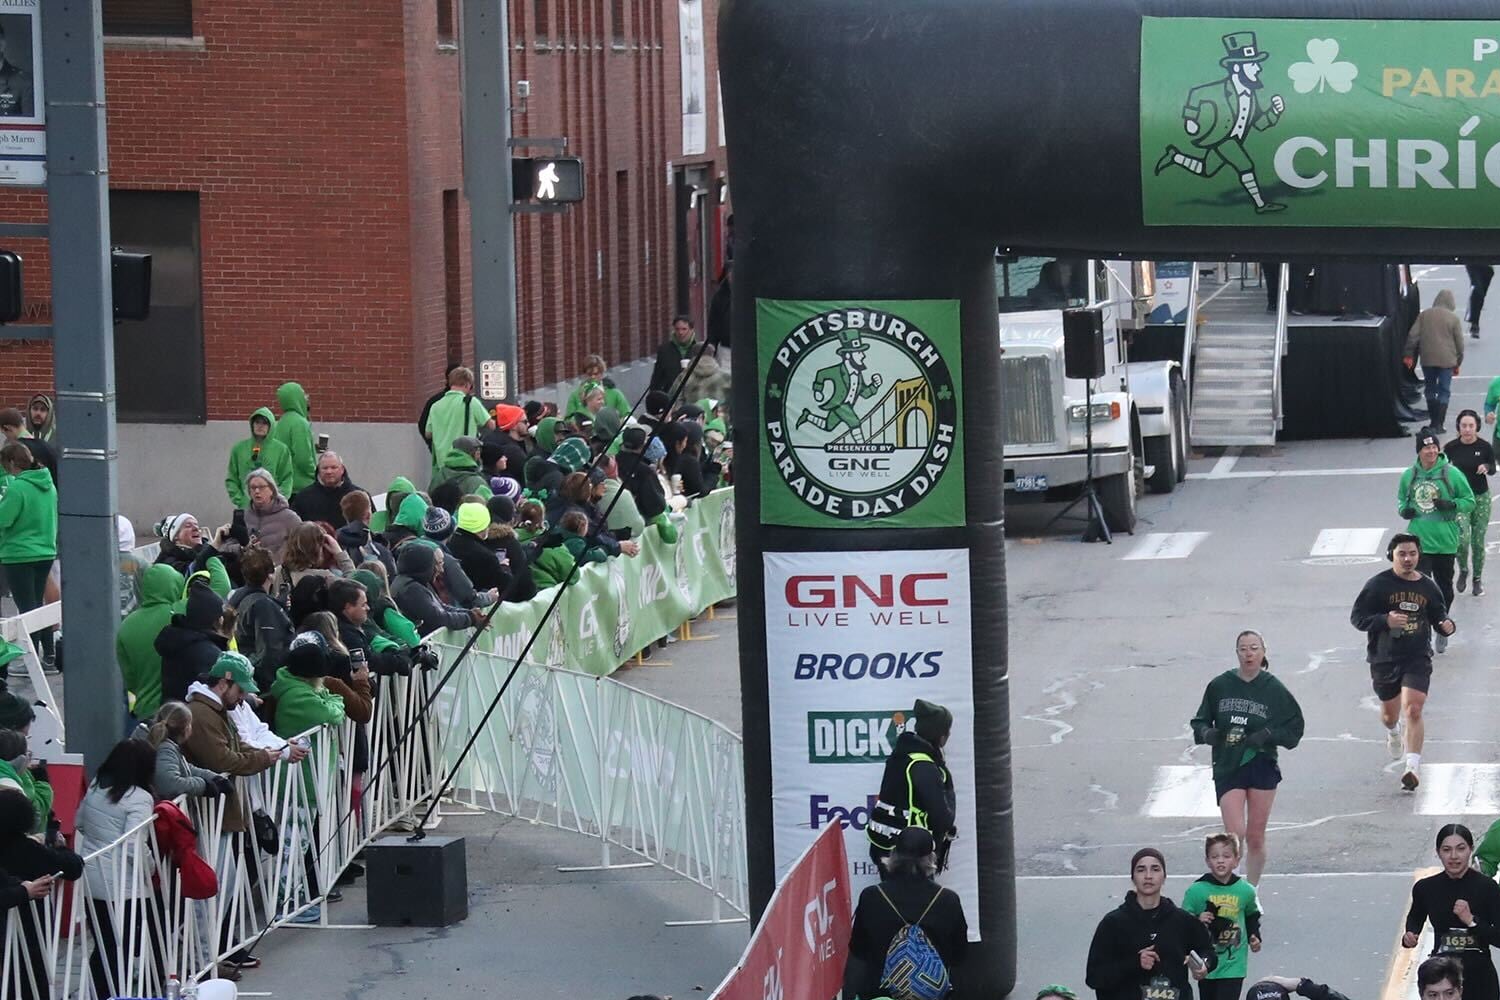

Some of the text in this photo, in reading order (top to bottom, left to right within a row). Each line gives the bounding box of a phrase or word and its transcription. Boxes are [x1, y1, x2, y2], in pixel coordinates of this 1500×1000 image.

[776, 311, 940, 368] PITTSBURGH
[827, 444, 892, 452] PRESENTED BY
[767, 421, 953, 517] PARADE DAY DASH
[828, 458, 890, 470] GNC
[785, 572, 949, 609] GNC
[788, 610, 949, 627] LIVE WELL
[794, 650, 944, 680] BROOKS
[1230, 715, 1248, 726] MOM
[810, 794, 879, 831] Fed
[1145, 988, 1175, 1000] 1442
